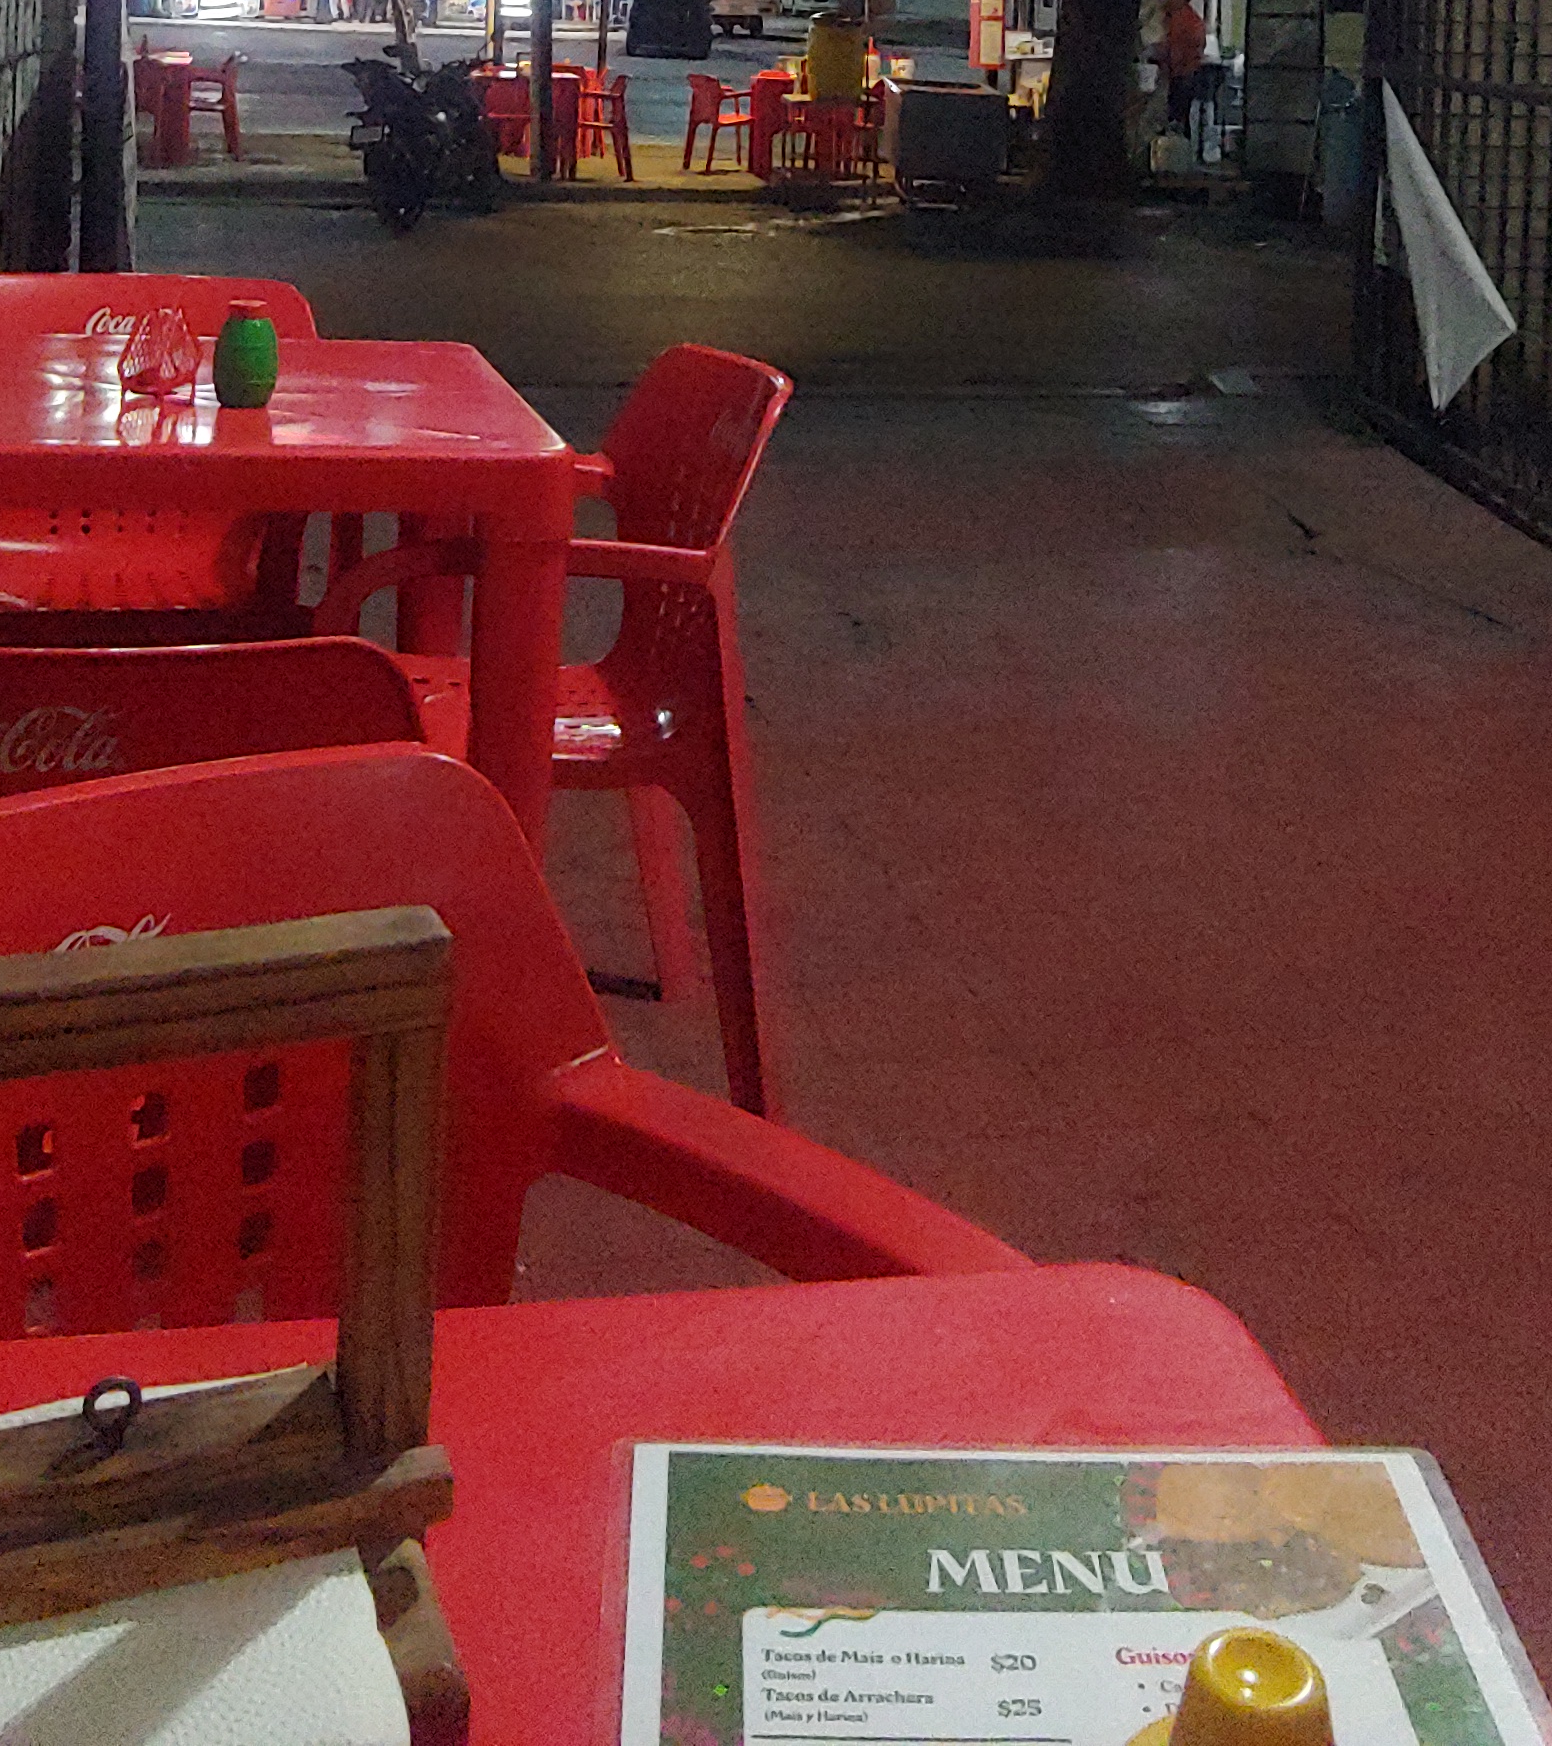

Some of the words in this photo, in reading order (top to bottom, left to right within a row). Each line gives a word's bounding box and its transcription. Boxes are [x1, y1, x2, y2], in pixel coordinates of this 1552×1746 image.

[806, 1491, 872, 1514] LAS
[877, 1492, 1027, 1516] LUPITAS
[925, 1536, 1170, 1595] MENÚ
[762, 1648, 811, 1662] Tacos
[816, 1649, 836, 1662] de
[891, 1654, 902, 1664] o
[905, 1652, 965, 1665] Harina
[991, 1653, 1037, 1673] $20
[762, 1687, 814, 1702] Tacos
[818, 1688, 839, 1702] de
[844, 1689, 934, 1705] Arrachera
[997, 1698, 1042, 1717] $25
[806, 1713, 814, 1723] y
